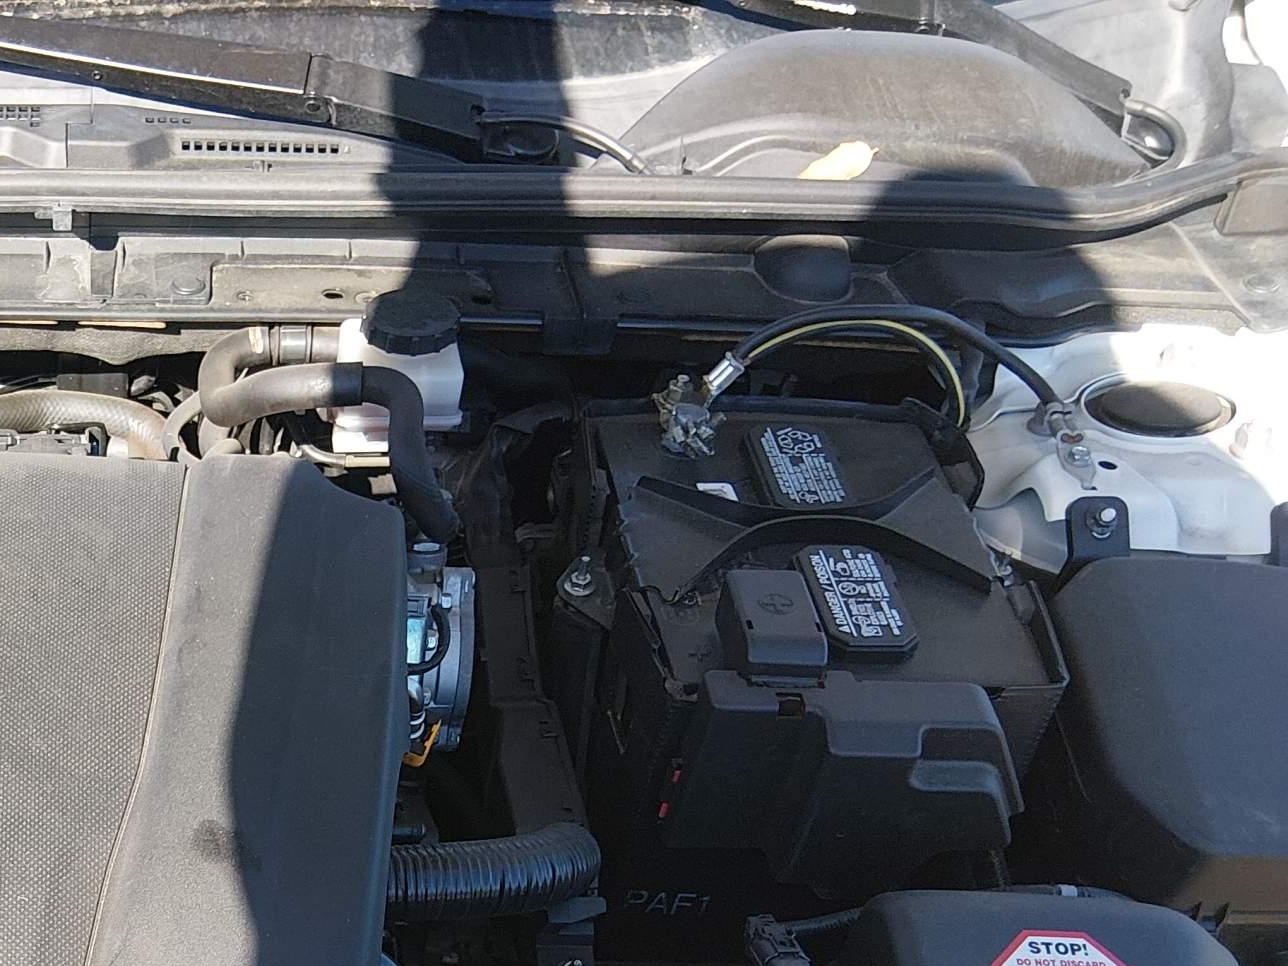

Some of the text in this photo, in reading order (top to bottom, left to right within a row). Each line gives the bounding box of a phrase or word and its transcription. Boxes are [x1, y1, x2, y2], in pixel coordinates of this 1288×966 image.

[809, 555, 831, 584] POISON
[824, 591, 848, 625] DANGER
[624, 889, 712, 916] PAF1
[1016, 958, 1031, 966] DO
[1035, 959, 1057, 966] NOT
[1028, 941, 1089, 956] STOP!
